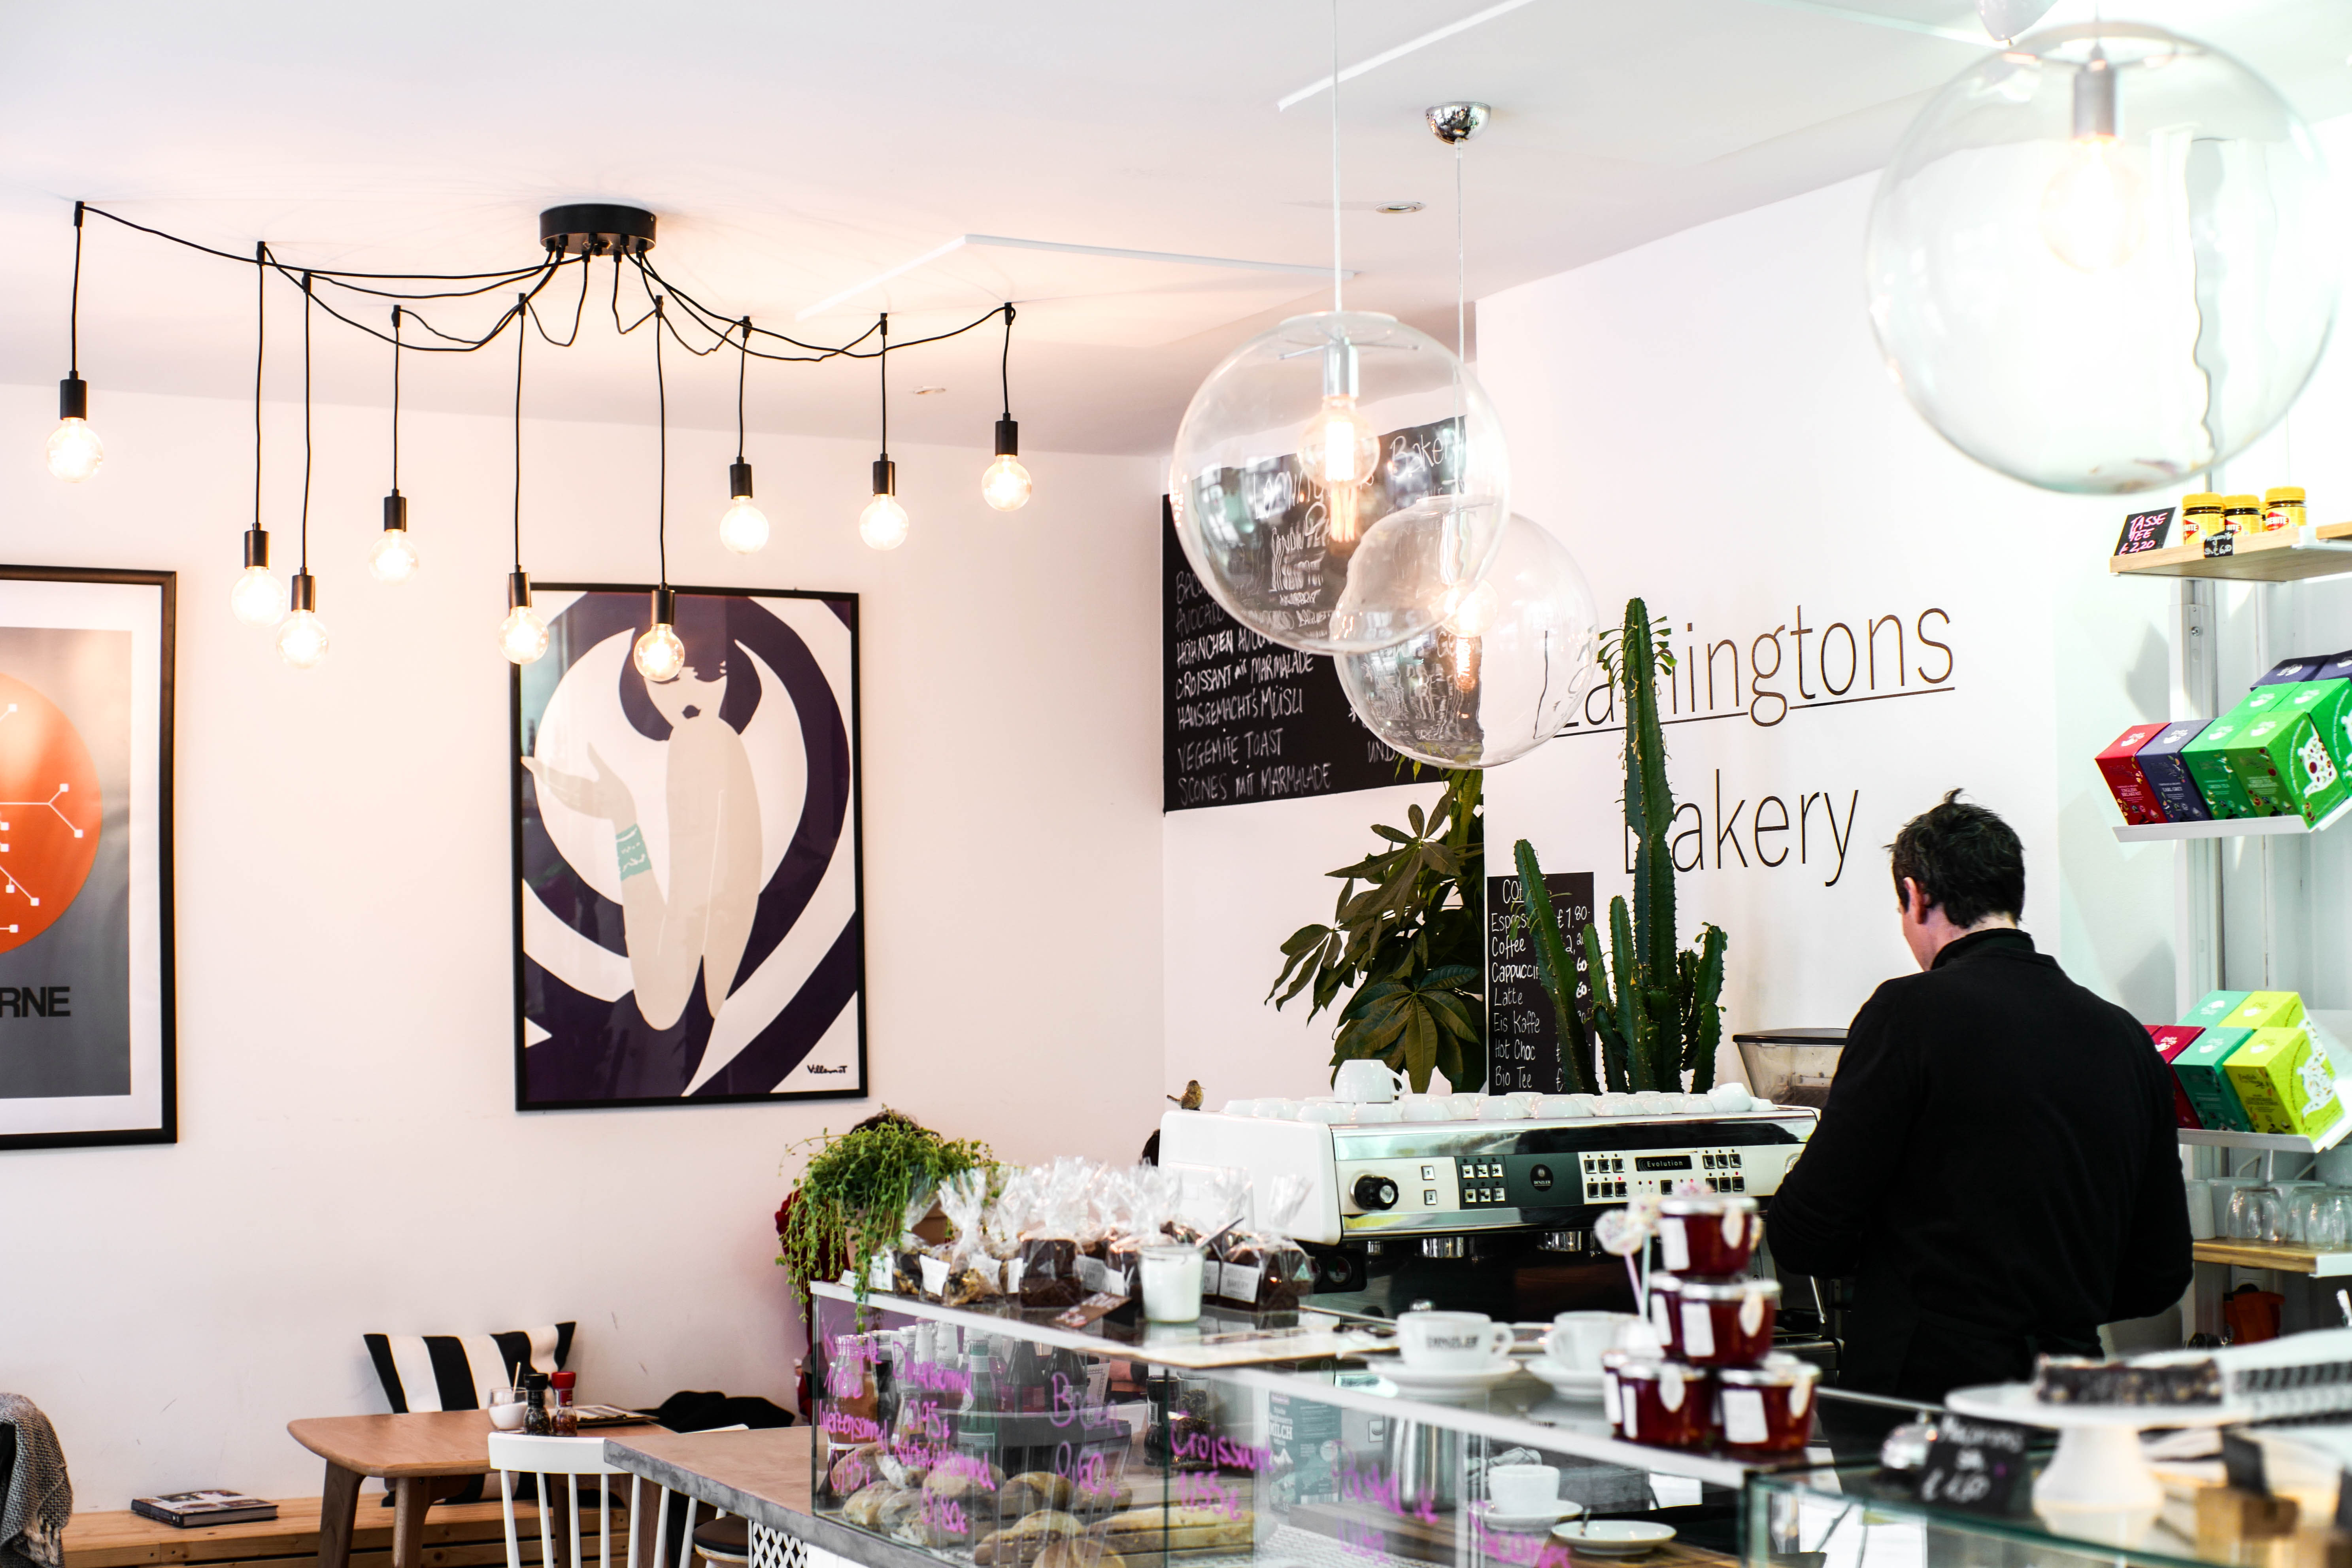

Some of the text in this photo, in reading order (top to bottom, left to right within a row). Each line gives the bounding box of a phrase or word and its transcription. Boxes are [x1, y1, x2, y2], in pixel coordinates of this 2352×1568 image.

[2130, 512, 2169, 532] TASSE
[1176, 664, 1231, 700] CROISSANT
[1251, 651, 1314, 683] MARMALADE
[1261, 685, 1303, 720] MÜSLI
[1244, 728, 1284, 759] TOAST
[1178, 774, 1227, 807] SCONES
[1261, 762, 1332, 796] MARMALADE
[1492, 934, 1527, 960] Coffee
[1492, 962, 1539, 983] Cappucci
[1494, 987, 1523, 1006] Latte
[1494, 1013, 1508, 1032] Eis
[1513, 1010, 1540, 1034] Kaffe
[1495, 1038, 1510, 1060] Hot
[1514, 1039, 1536, 1060] Choc
[1495, 1066, 1510, 1087] Bio
[1516, 1066, 1533, 1089] Tee
